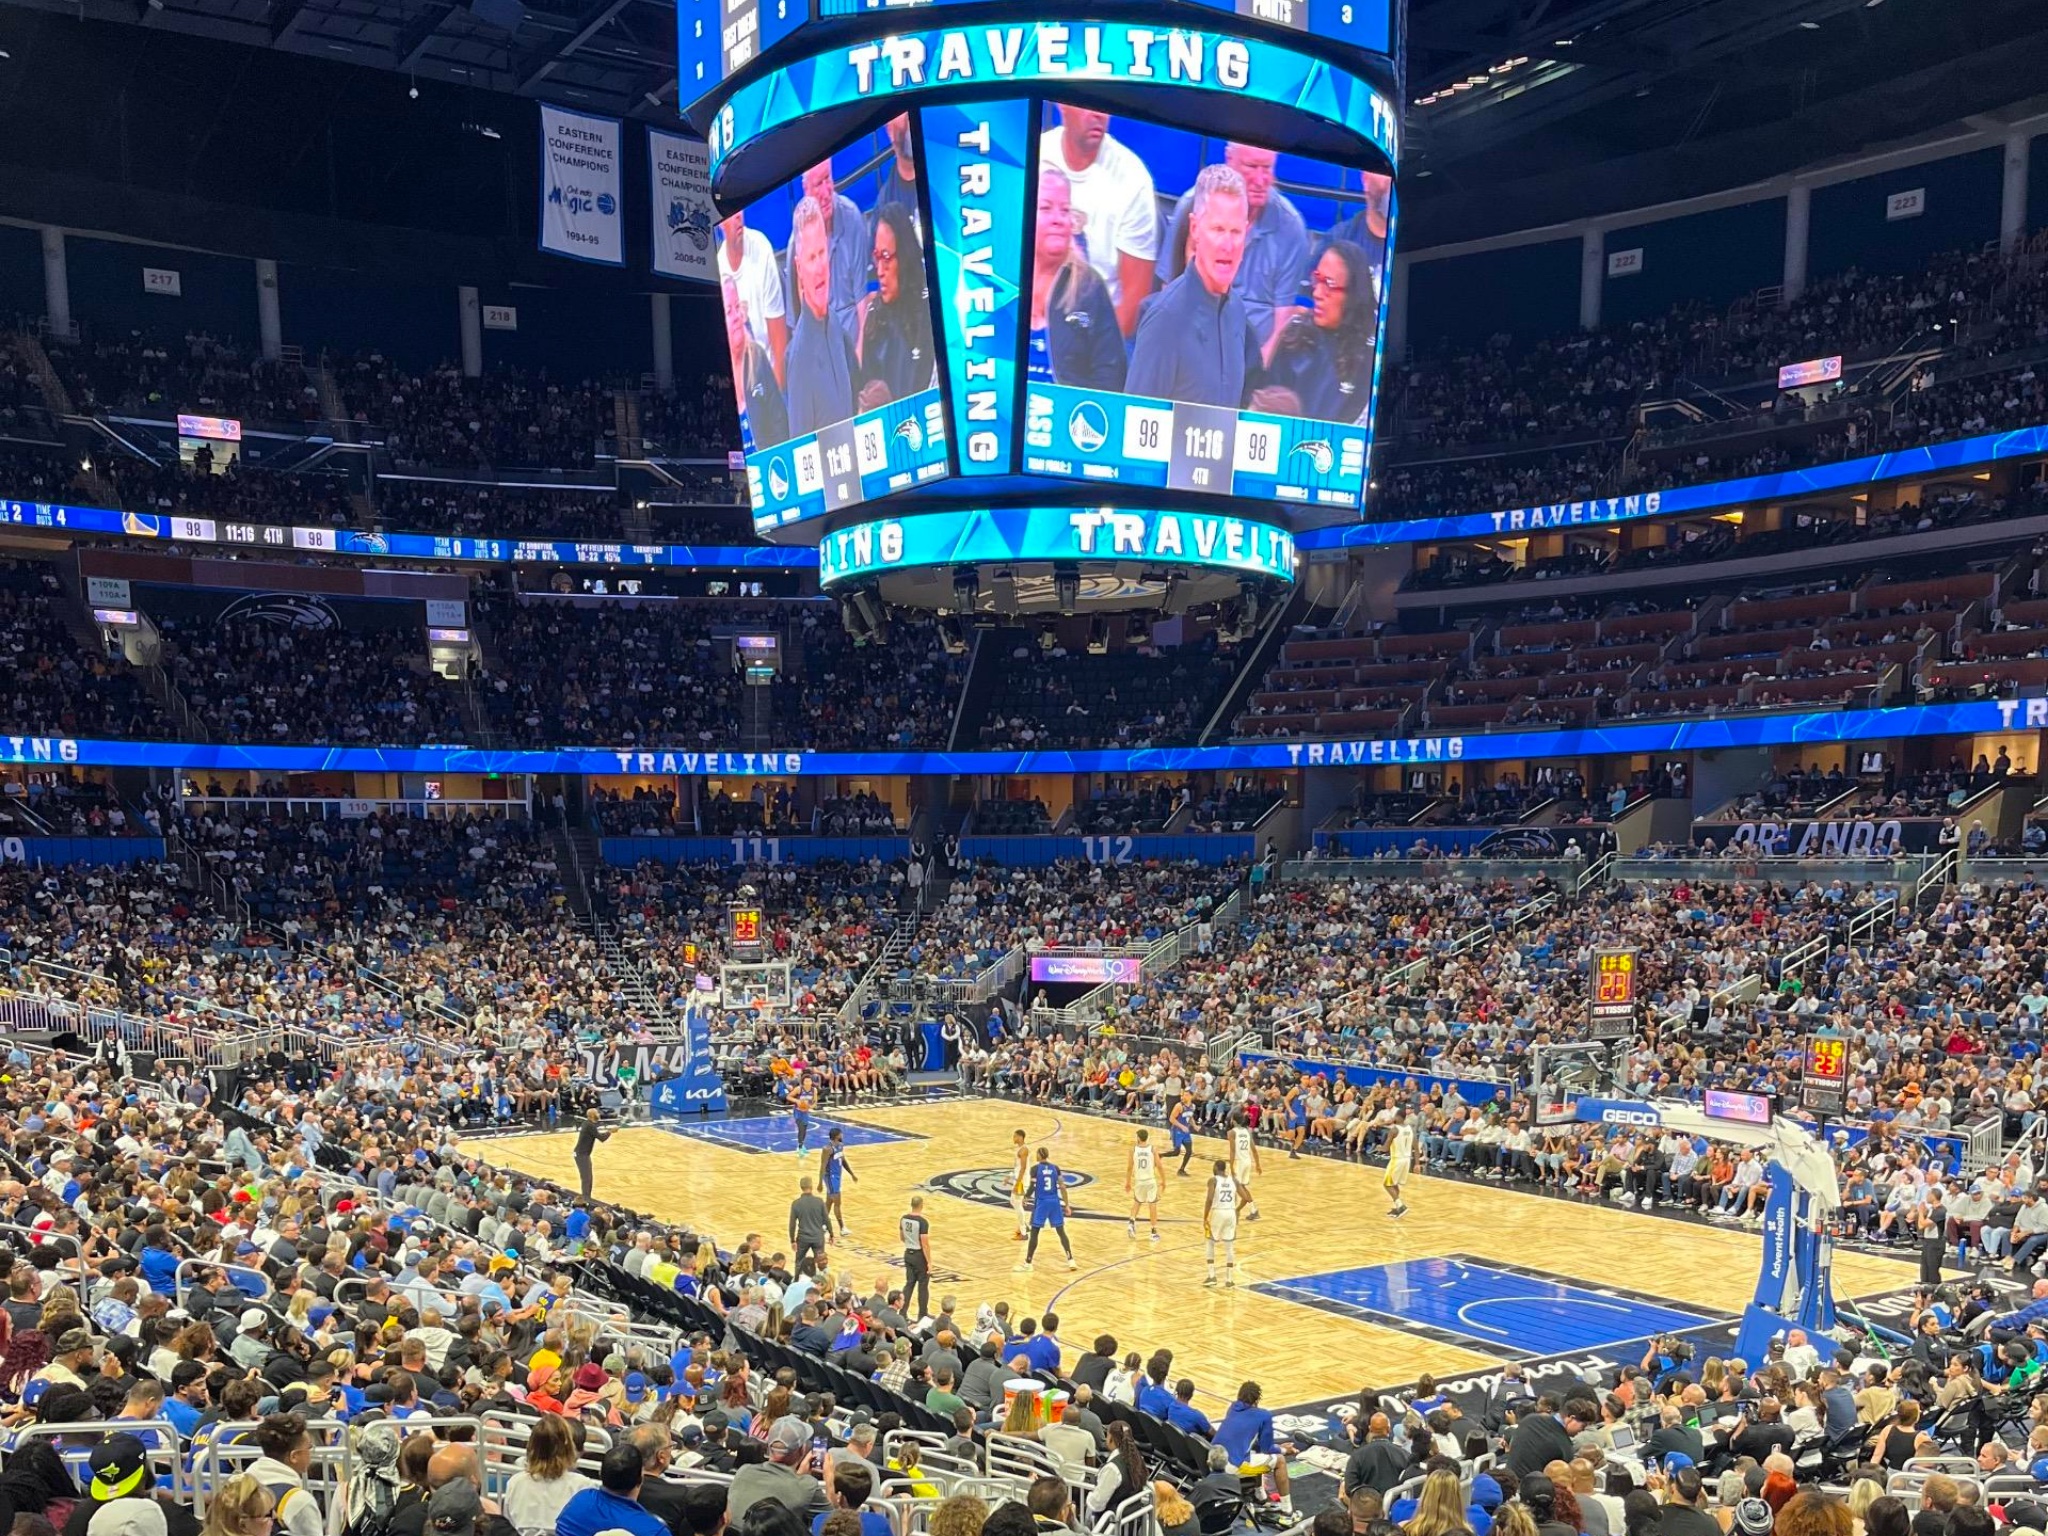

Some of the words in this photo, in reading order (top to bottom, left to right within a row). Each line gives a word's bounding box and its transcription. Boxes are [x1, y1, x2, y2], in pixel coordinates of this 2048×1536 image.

[1342, 5, 1353, 24] 3
[849, 25, 1250, 94] TRAVELING
[696, 61, 704, 80] 1
[558, 125, 603, 143] EASTERN
[548, 137, 613, 160] CONFERENCE
[666, 149, 707, 166] EASTERN
[552, 153, 610, 173] CHAMPIONS
[1894, 196, 1918, 210] 223
[565, 230, 599, 245] 1994-95
[1615, 255, 1636, 268] 222
[150, 274, 173, 286] 217
[958, 121, 999, 462] TRAVELING
[490, 310, 510, 322] 218
[1139, 418, 1159, 449] 98
[1185, 426, 1224, 460] 11:16
[863, 432, 879, 462] 98
[1249, 433, 1268, 461] 98
[12, 504, 22, 521] 2
[56, 508, 67, 527] 4
[1491, 493, 1662, 532] TRAVELING
[186, 521, 201, 537] 98
[225, 525, 255, 542] 11:16
[263, 528, 284, 544] 4TH
[308, 532, 323, 547] 98
[453, 540, 462, 556] 0
[491, 542, 500, 558] 3
[1996, 698, 2047, 727] TR
[1287, 737, 1465, 767] TRAVELING
[616, 752, 802, 774] TRAVELING
[349, 802, 369, 812] 110
[1734, 820, 1902, 856] ORANDO
[731, 837, 784, 867] 111
[1082, 836, 1133, 865] 112
[736, 921, 756, 938] 23
[1105, 959, 1124, 980] 50
[1600, 972, 1627, 1000] 23
[1605, 1005, 1633, 1015] TISSOT
[1815, 1055, 1836, 1074] 23
[1815, 1078, 1842, 1088] TISSOT
[1602, 1108, 1658, 1126] GEICO
[1240, 1140, 1249, 1151] 22
[1137, 1158, 1148, 1169] 10
[1043, 1176, 1052, 1191] 3
[1220, 1190, 1233, 1203] 23
[1771, 1206, 1786, 1279] AdventHealth
[1107, 1385, 1118, 1402] 4
